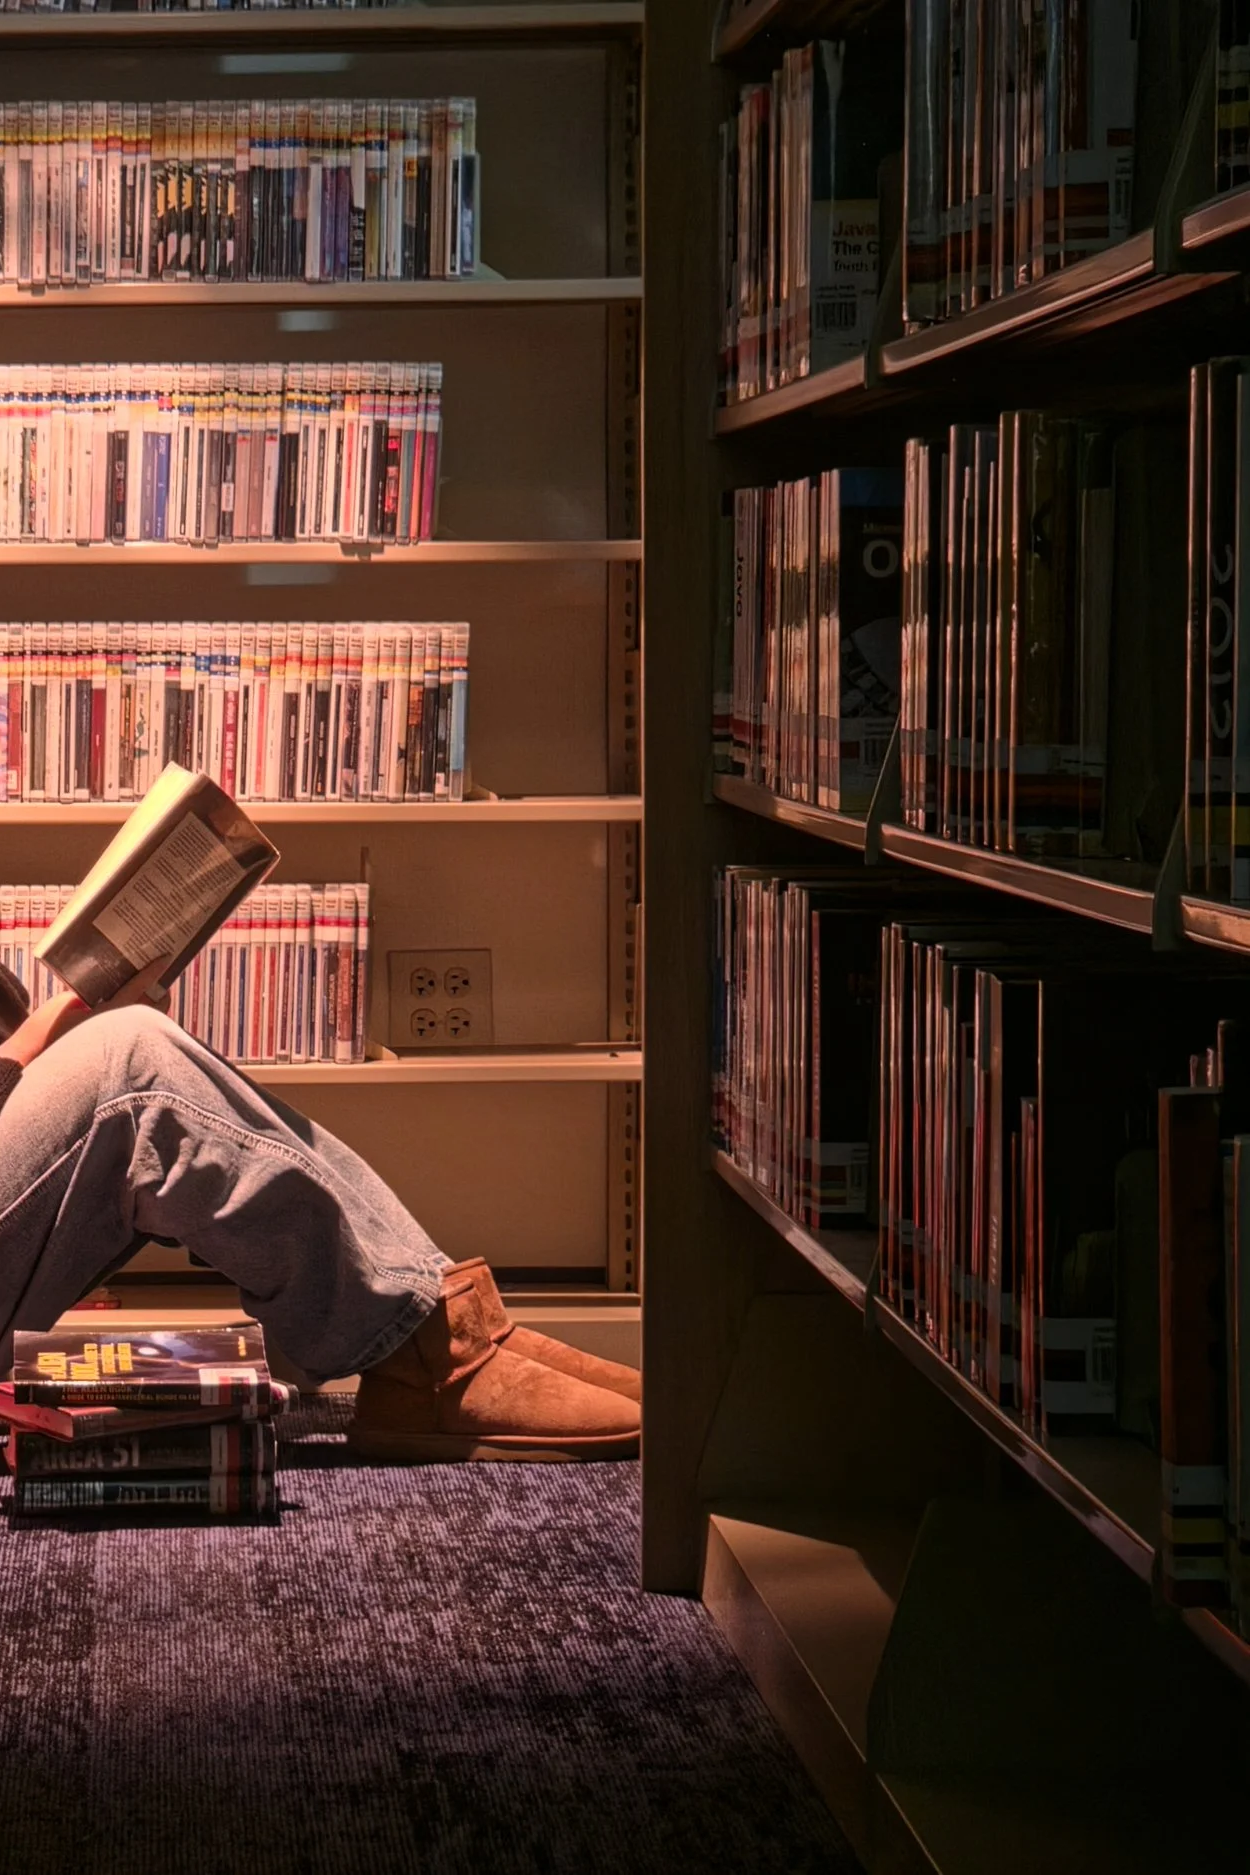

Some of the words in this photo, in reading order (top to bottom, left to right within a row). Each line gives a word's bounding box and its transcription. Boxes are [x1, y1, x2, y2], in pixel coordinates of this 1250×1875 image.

[833, 240, 862, 255] The
[30, 1441, 105, 1470] AREA
[111, 1436, 141, 1468] 51
